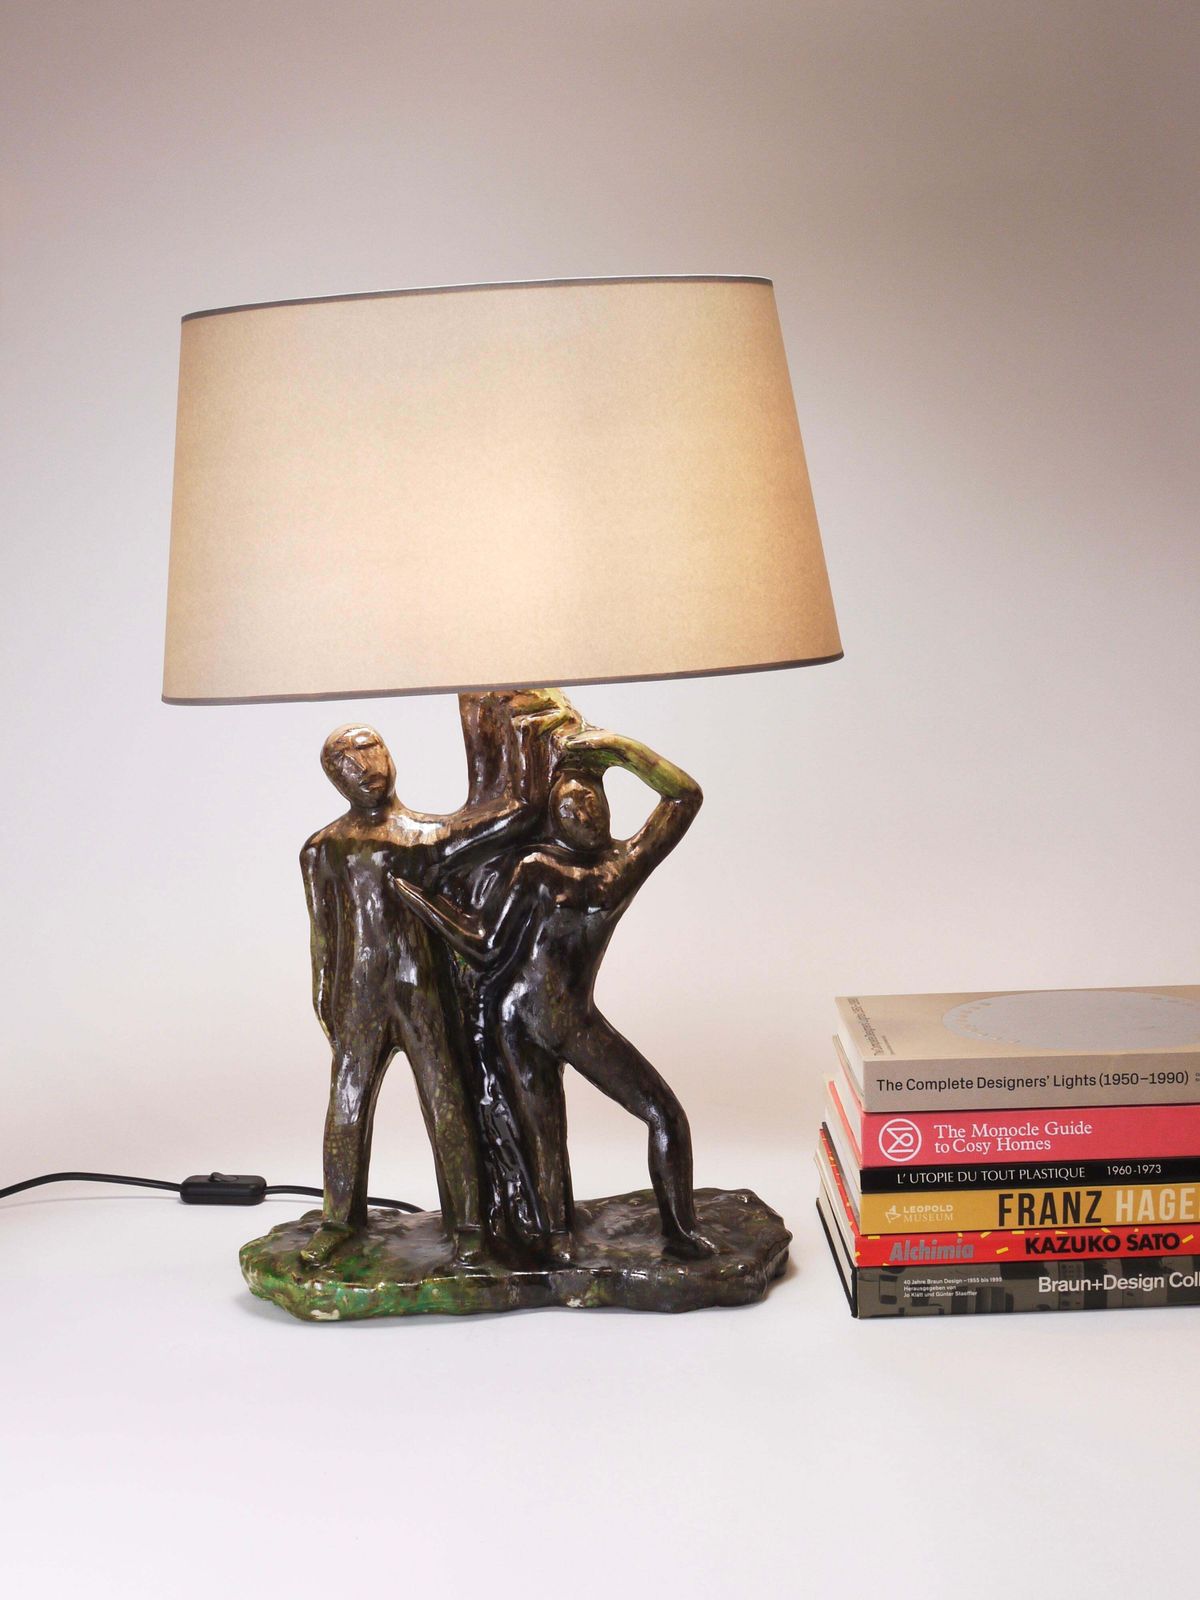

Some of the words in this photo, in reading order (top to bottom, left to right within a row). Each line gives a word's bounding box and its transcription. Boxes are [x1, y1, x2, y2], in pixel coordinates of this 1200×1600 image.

[876, 1079, 903, 1091] The
[906, 1077, 974, 1092] Complete
[1053, 1074, 1097, 1089] Lights
[934, 1125, 966, 1139] The
[971, 1122, 1039, 1137] Monocle
[1044, 1121, 1093, 1136] Guide
[934, 1142, 950, 1154] to
[952, 1139, 991, 1155] Cosy
[996, 1137, 1051, 1152] Homes
[957, 1171, 977, 1182] DU
[981, 1169, 1015, 1181] TOUT
[1019, 1167, 1086, 1181] PLASTIQUE
[1106, 1164, 1162, 1176] 1960-1973
[903, 1204, 954, 1213] LEOPOLD
[998, 1190, 1103, 1227] FRANZ
[1115, 1187, 1200, 1223] HAGE
[903, 1213, 954, 1223] MUSEUM
[889, 1240, 974, 1261] Alchimia
[1025, 1233, 1121, 1255] KAZUKO
[1126, 1232, 1181, 1251] SATO
[1038, 1273, 1165, 1293] Braun+Design
